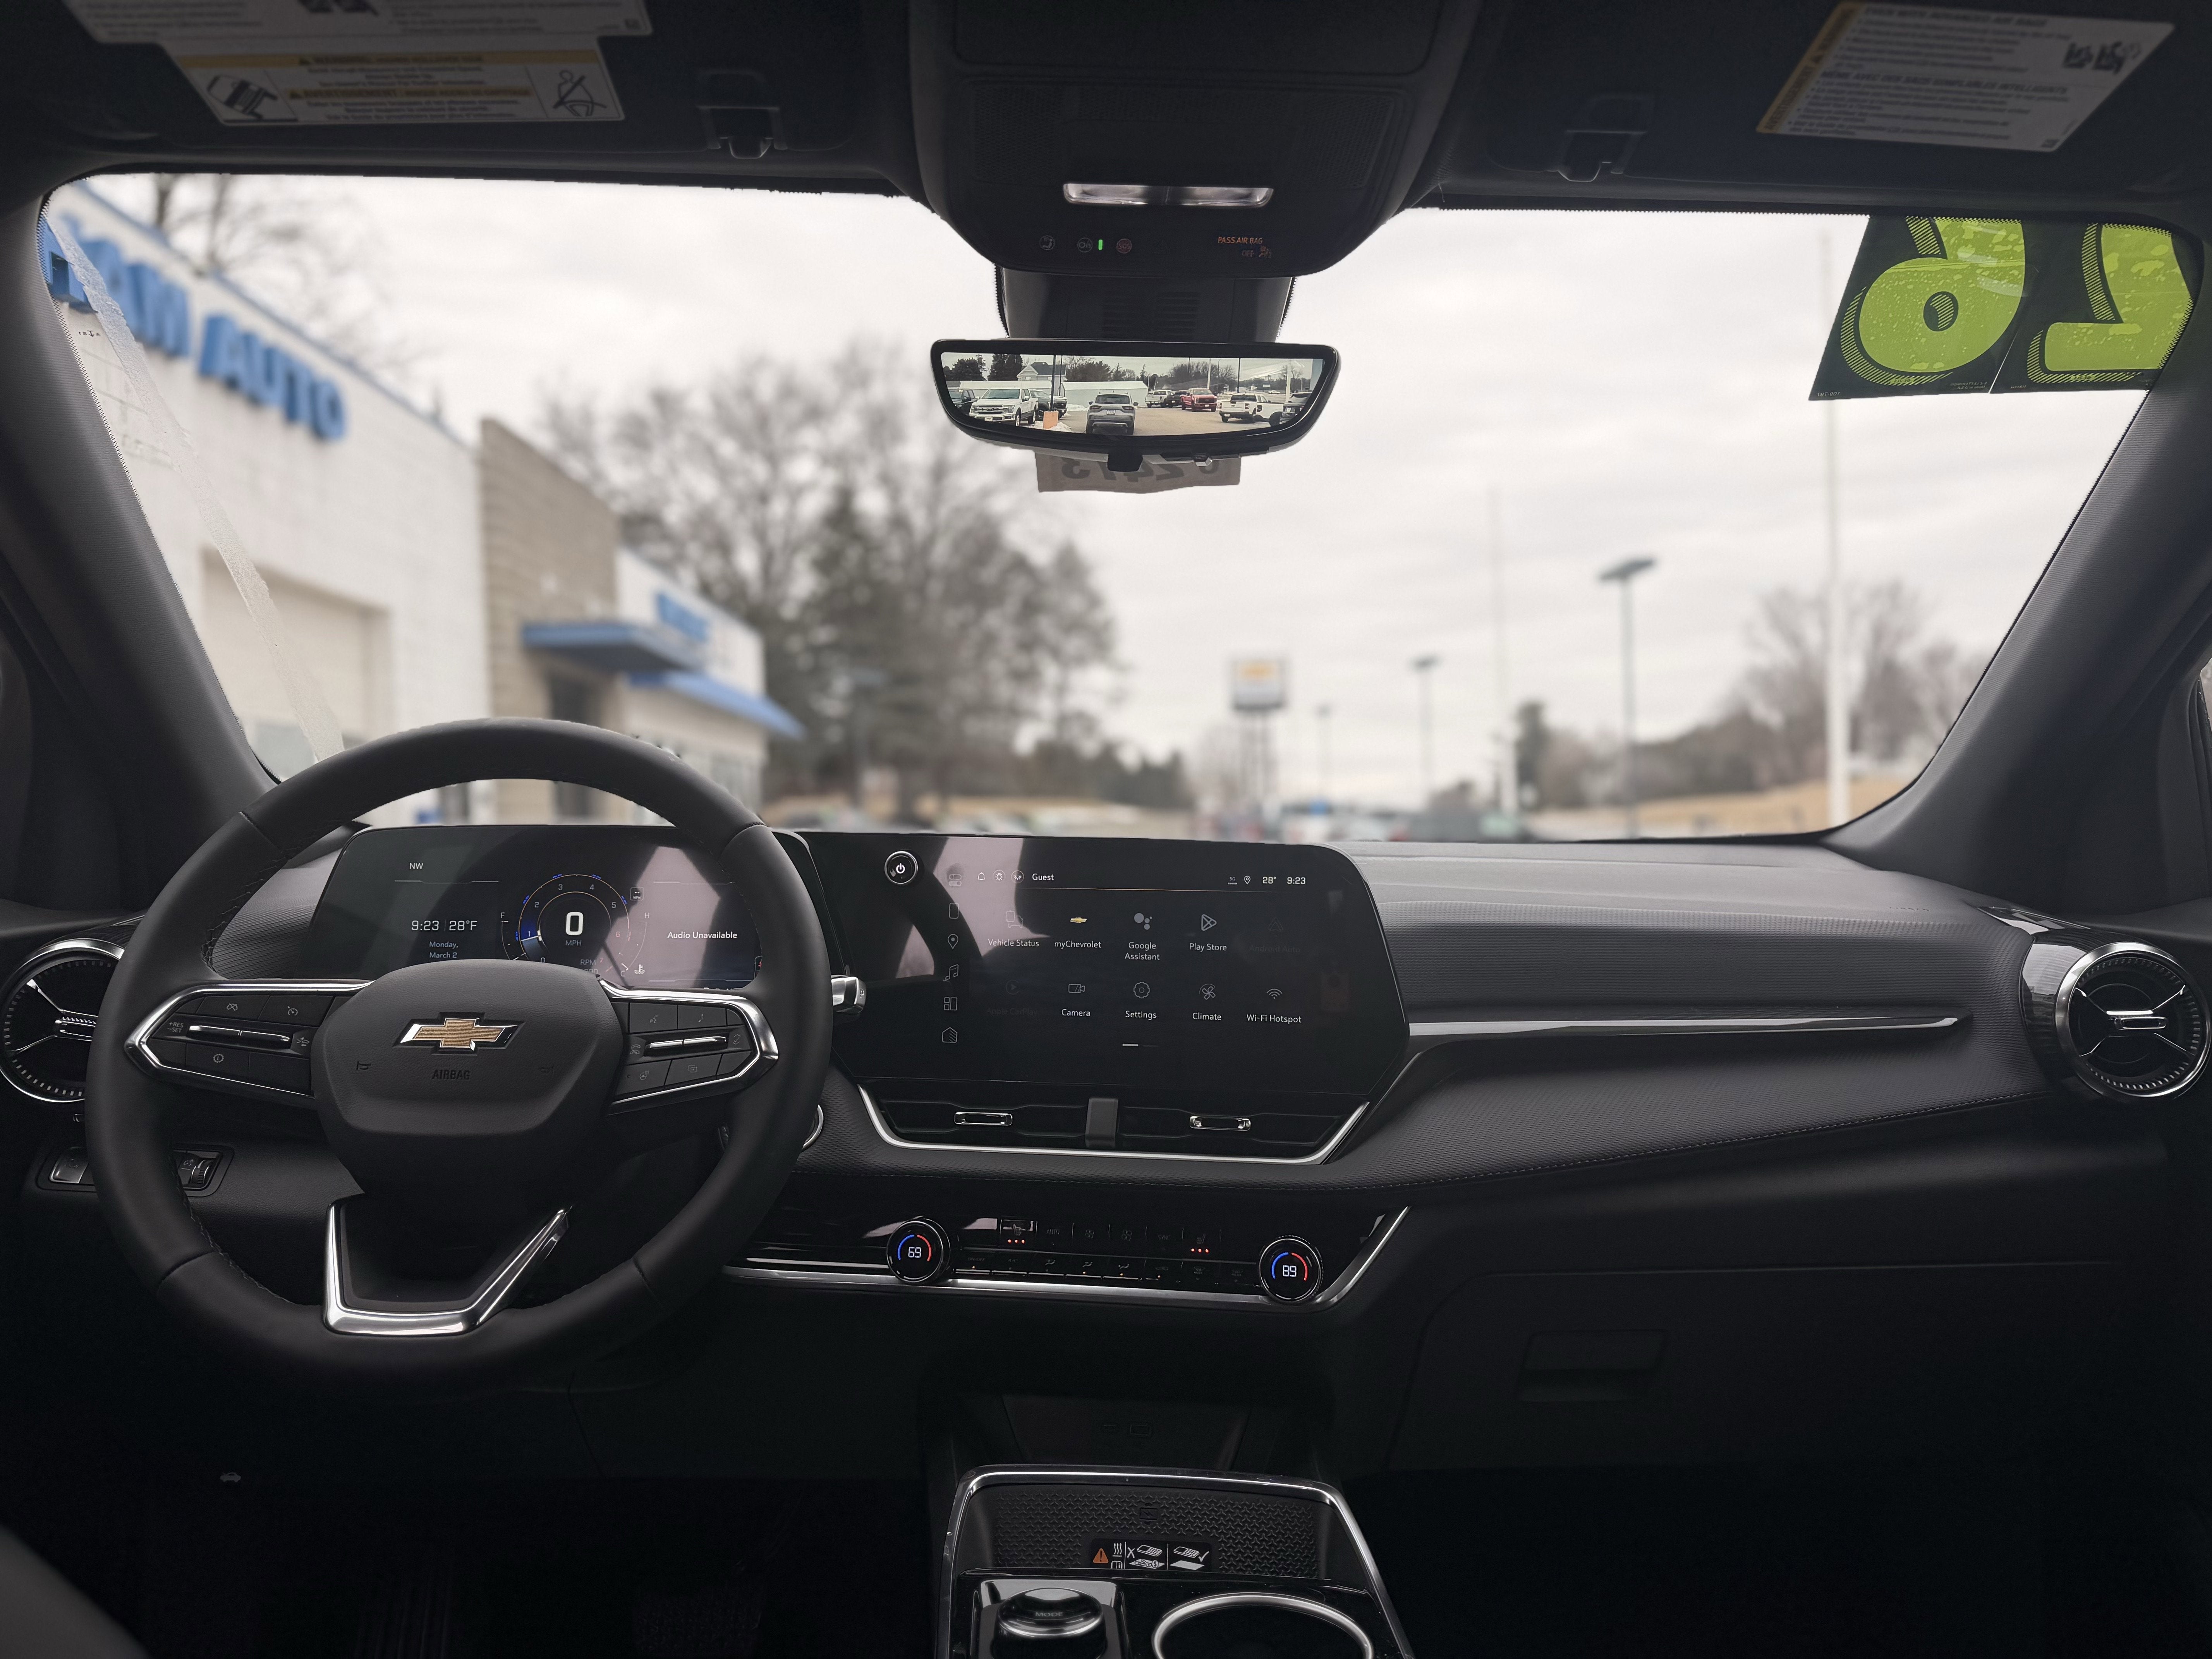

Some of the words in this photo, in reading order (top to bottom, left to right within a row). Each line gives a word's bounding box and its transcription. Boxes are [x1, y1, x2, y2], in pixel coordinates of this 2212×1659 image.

[1032, 873, 1054, 882] Guest
[411, 920, 440, 931] 9:23
[449, 920, 477, 931] 28°F
[565, 912, 584, 936] 0
[429, 941, 459, 949] Monday,
[988, 938, 1015, 947] Vehicle
[1016, 939, 1039, 948] Status
[1054, 940, 1101, 950] myChevrolet
[1128, 942, 1156, 951] Google
[1189, 943, 1205, 952] Play
[1010, 1008, 1037, 1017] CarPlay
[1061, 1008, 1091, 1017] Camera
[1125, 1010, 1157, 1020] Settings
[1192, 1012, 1222, 1021] Climate
[1247, 1013, 1268, 1022] Wi-Fi
[1269, 1013, 1302, 1024] Hotspot
[431, 1070, 470, 1080] AIRBAG
[908, 1247, 922, 1258] 69
